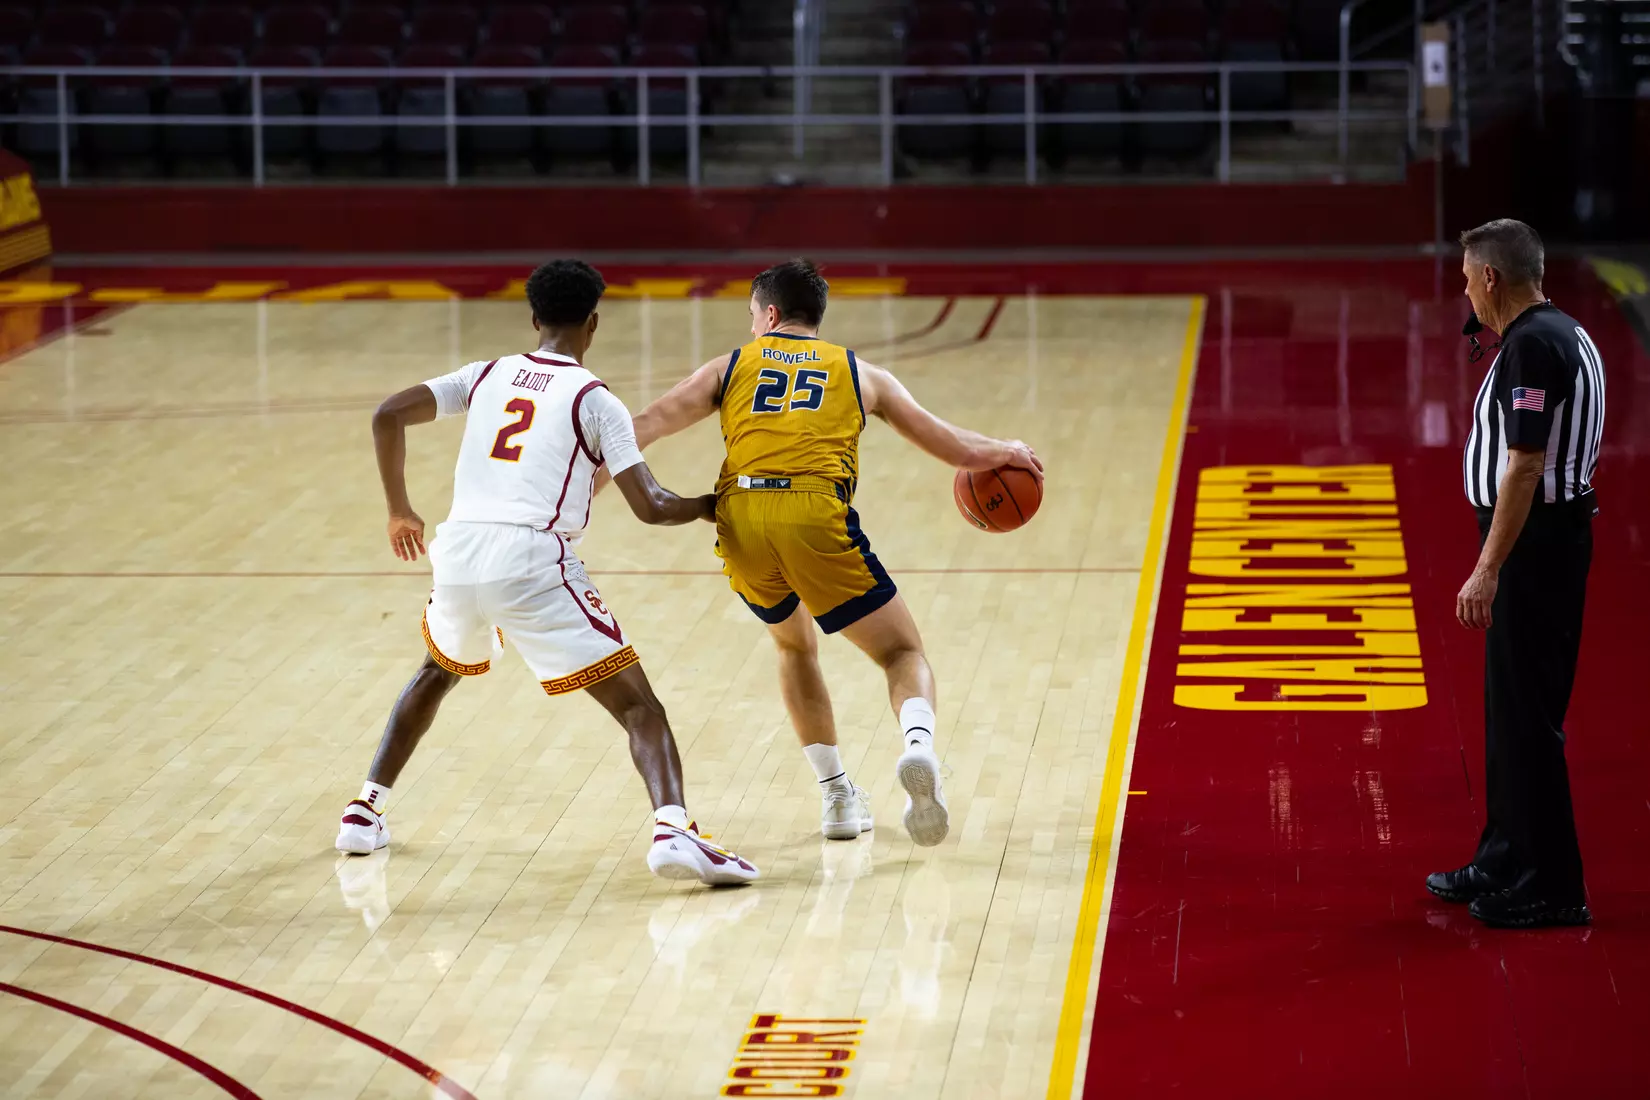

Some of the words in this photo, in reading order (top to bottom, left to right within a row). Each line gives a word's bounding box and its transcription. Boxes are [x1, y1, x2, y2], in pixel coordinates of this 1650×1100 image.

[511, 368, 554, 392] EADDY
[761, 347, 822, 365] ROWELL
[750, 367, 829, 414] 25
[489, 397, 537, 463] 2
[1188, 463, 1409, 578] CENTER
[1173, 583, 1429, 711] GALEN
[719, 1013, 868, 1097] COURT
